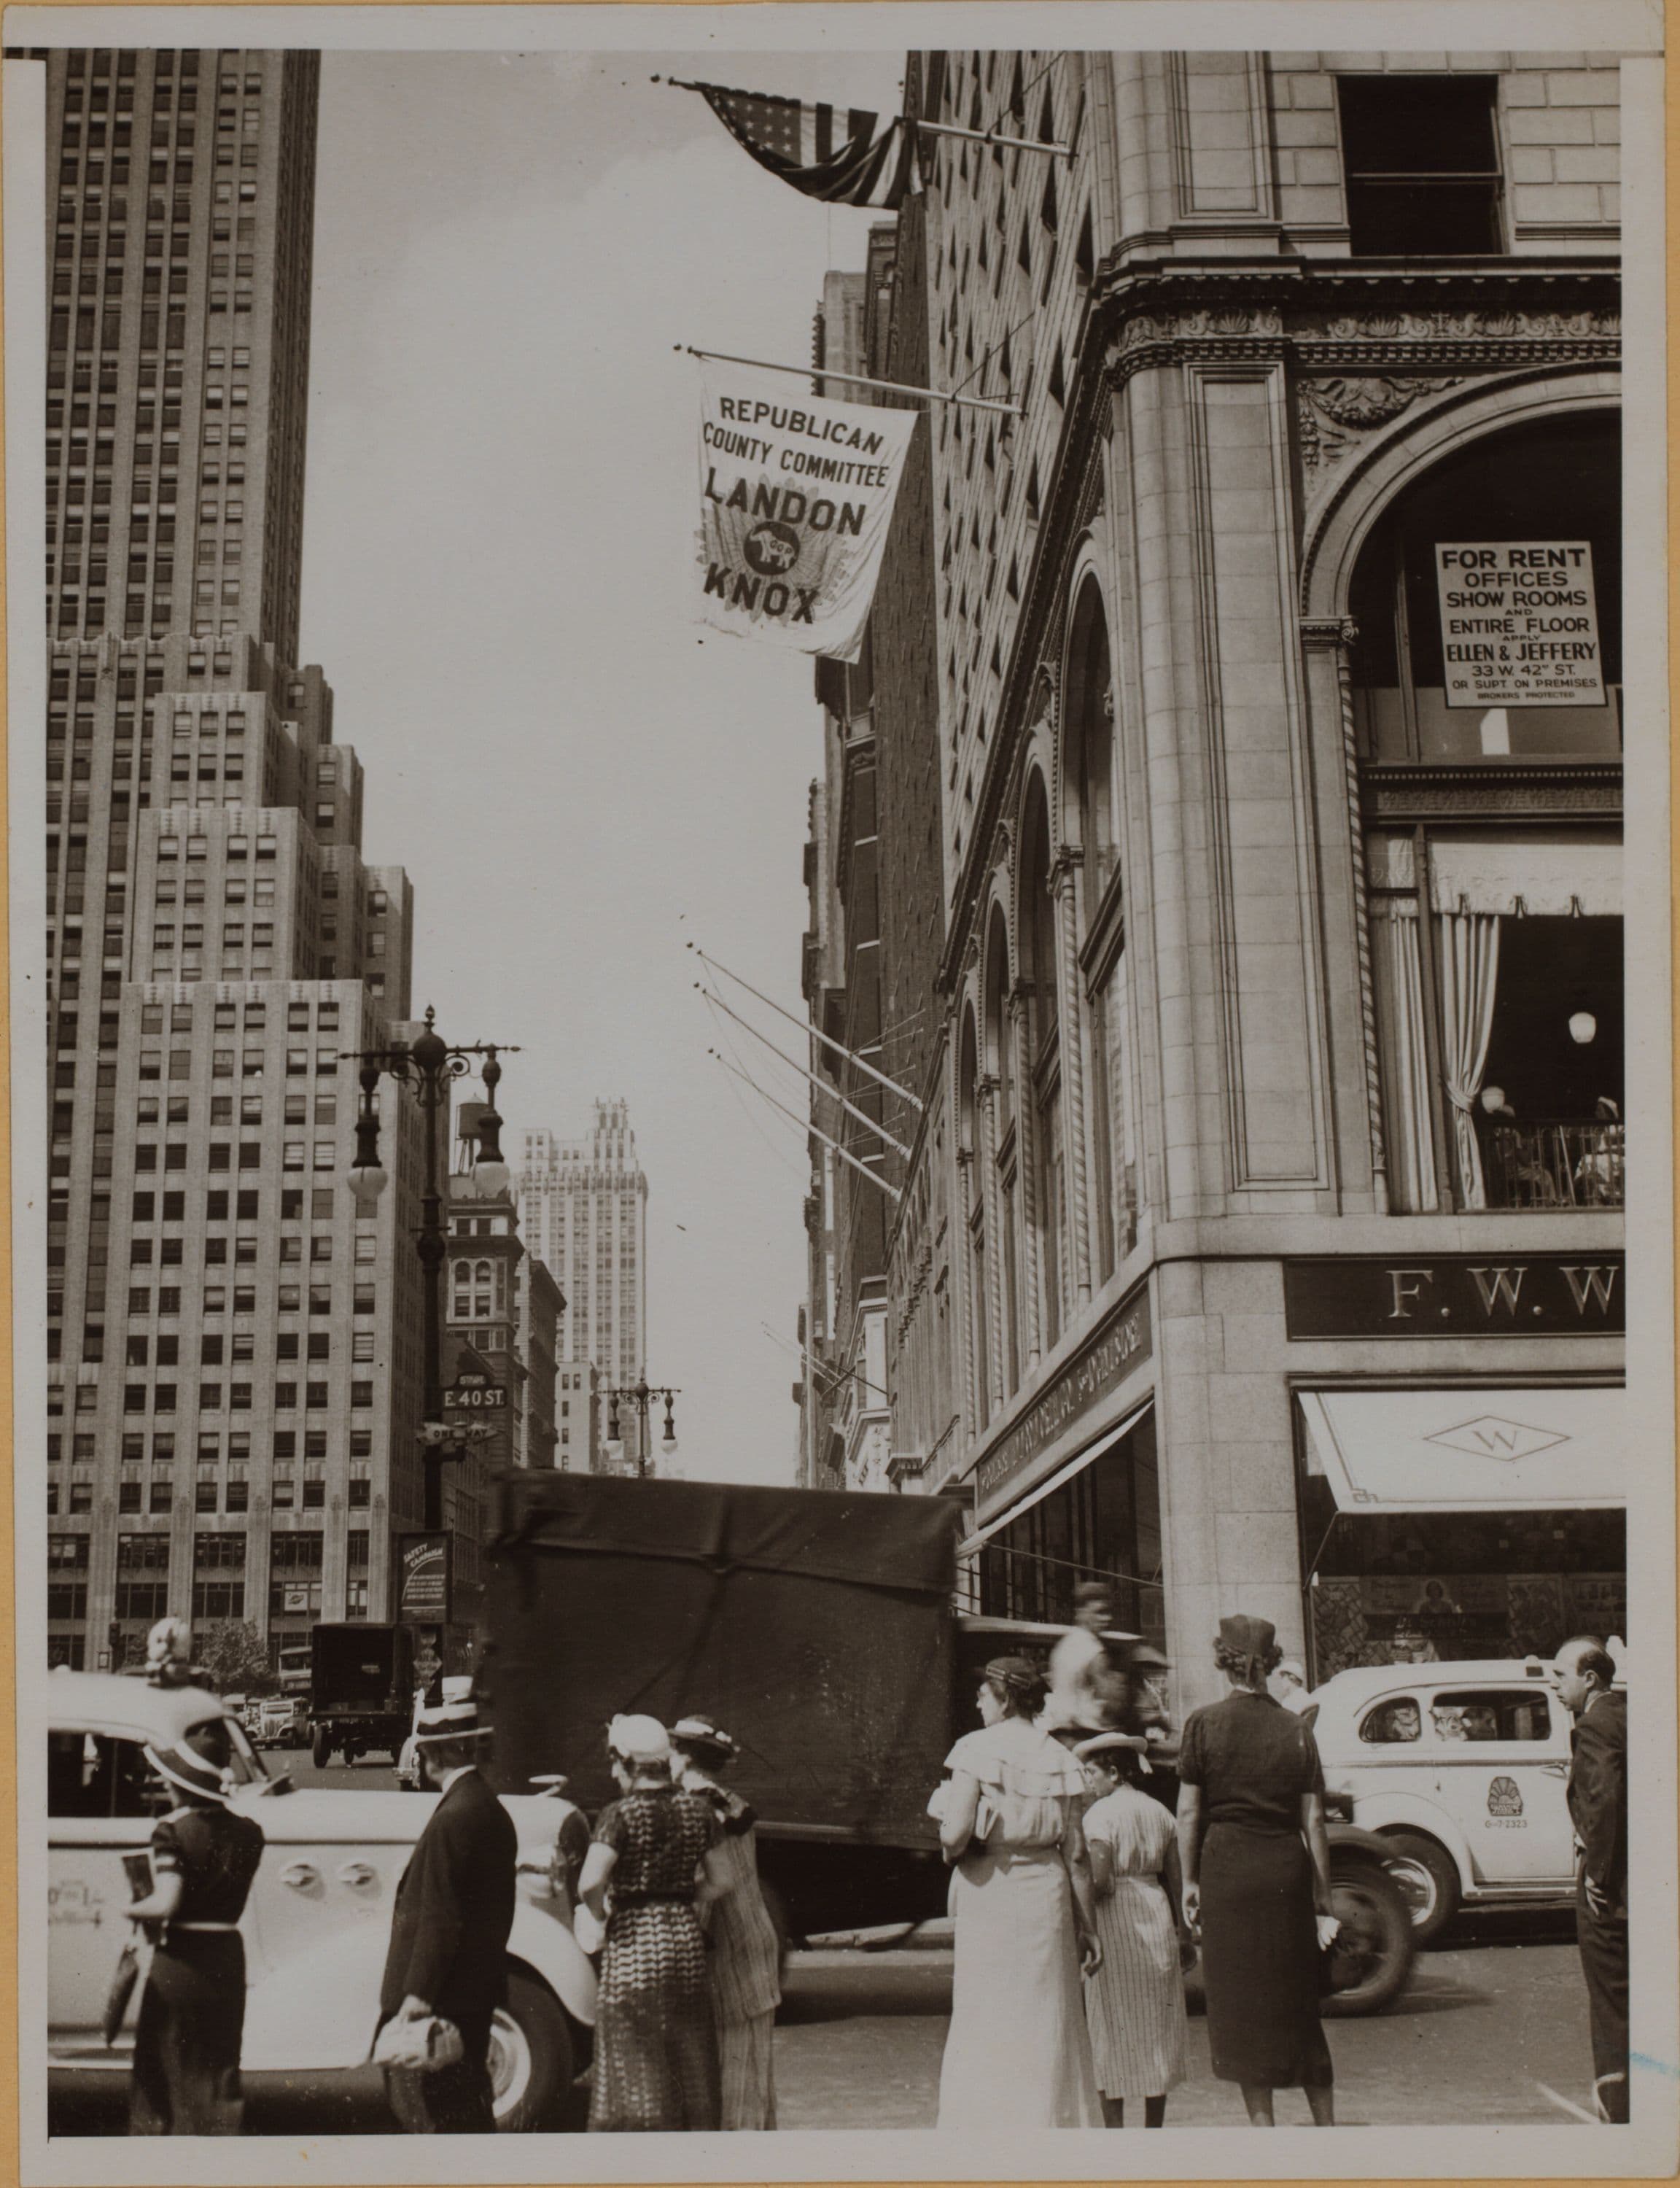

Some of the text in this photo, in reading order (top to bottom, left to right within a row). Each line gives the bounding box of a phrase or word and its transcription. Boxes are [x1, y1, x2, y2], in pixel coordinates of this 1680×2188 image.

[719, 396, 884, 456] REPUBLICAN
[703, 422, 890, 488] COUNTY COMMITTEE
[704, 467, 866, 536] LANDON
[769, 539, 793, 555] GOP
[1442, 548, 1586, 570] FOR RENT
[1464, 571, 1568, 588] OFFICES
[703, 562, 819, 624] KNOX
[1447, 590, 1587, 608] SHOW ROOMS
[1450, 618, 1590, 634] ENTIRE FLOOR
[1446, 642, 1596, 662] ELLEN & JEFFERY
[1471, 665, 1493, 677] 33
[1498, 664, 1514, 676] W.
[1555, 664, 1576, 675] ST.
[1452, 680, 1468, 689] OR
[1514, 679, 1529, 688] ON
[1536, 678, 1598, 688] PREMISES
[1477, 691, 1575, 700] BROKERS PROTECTED
[459, 1390, 481, 1406] 40
[433, 1429, 488, 1438] ONE WAY
[1473, 1429, 1518, 1451] W
[403, 1542, 428, 1564] SAFETY
[410, 1546, 443, 1568] CAMPAIGN
